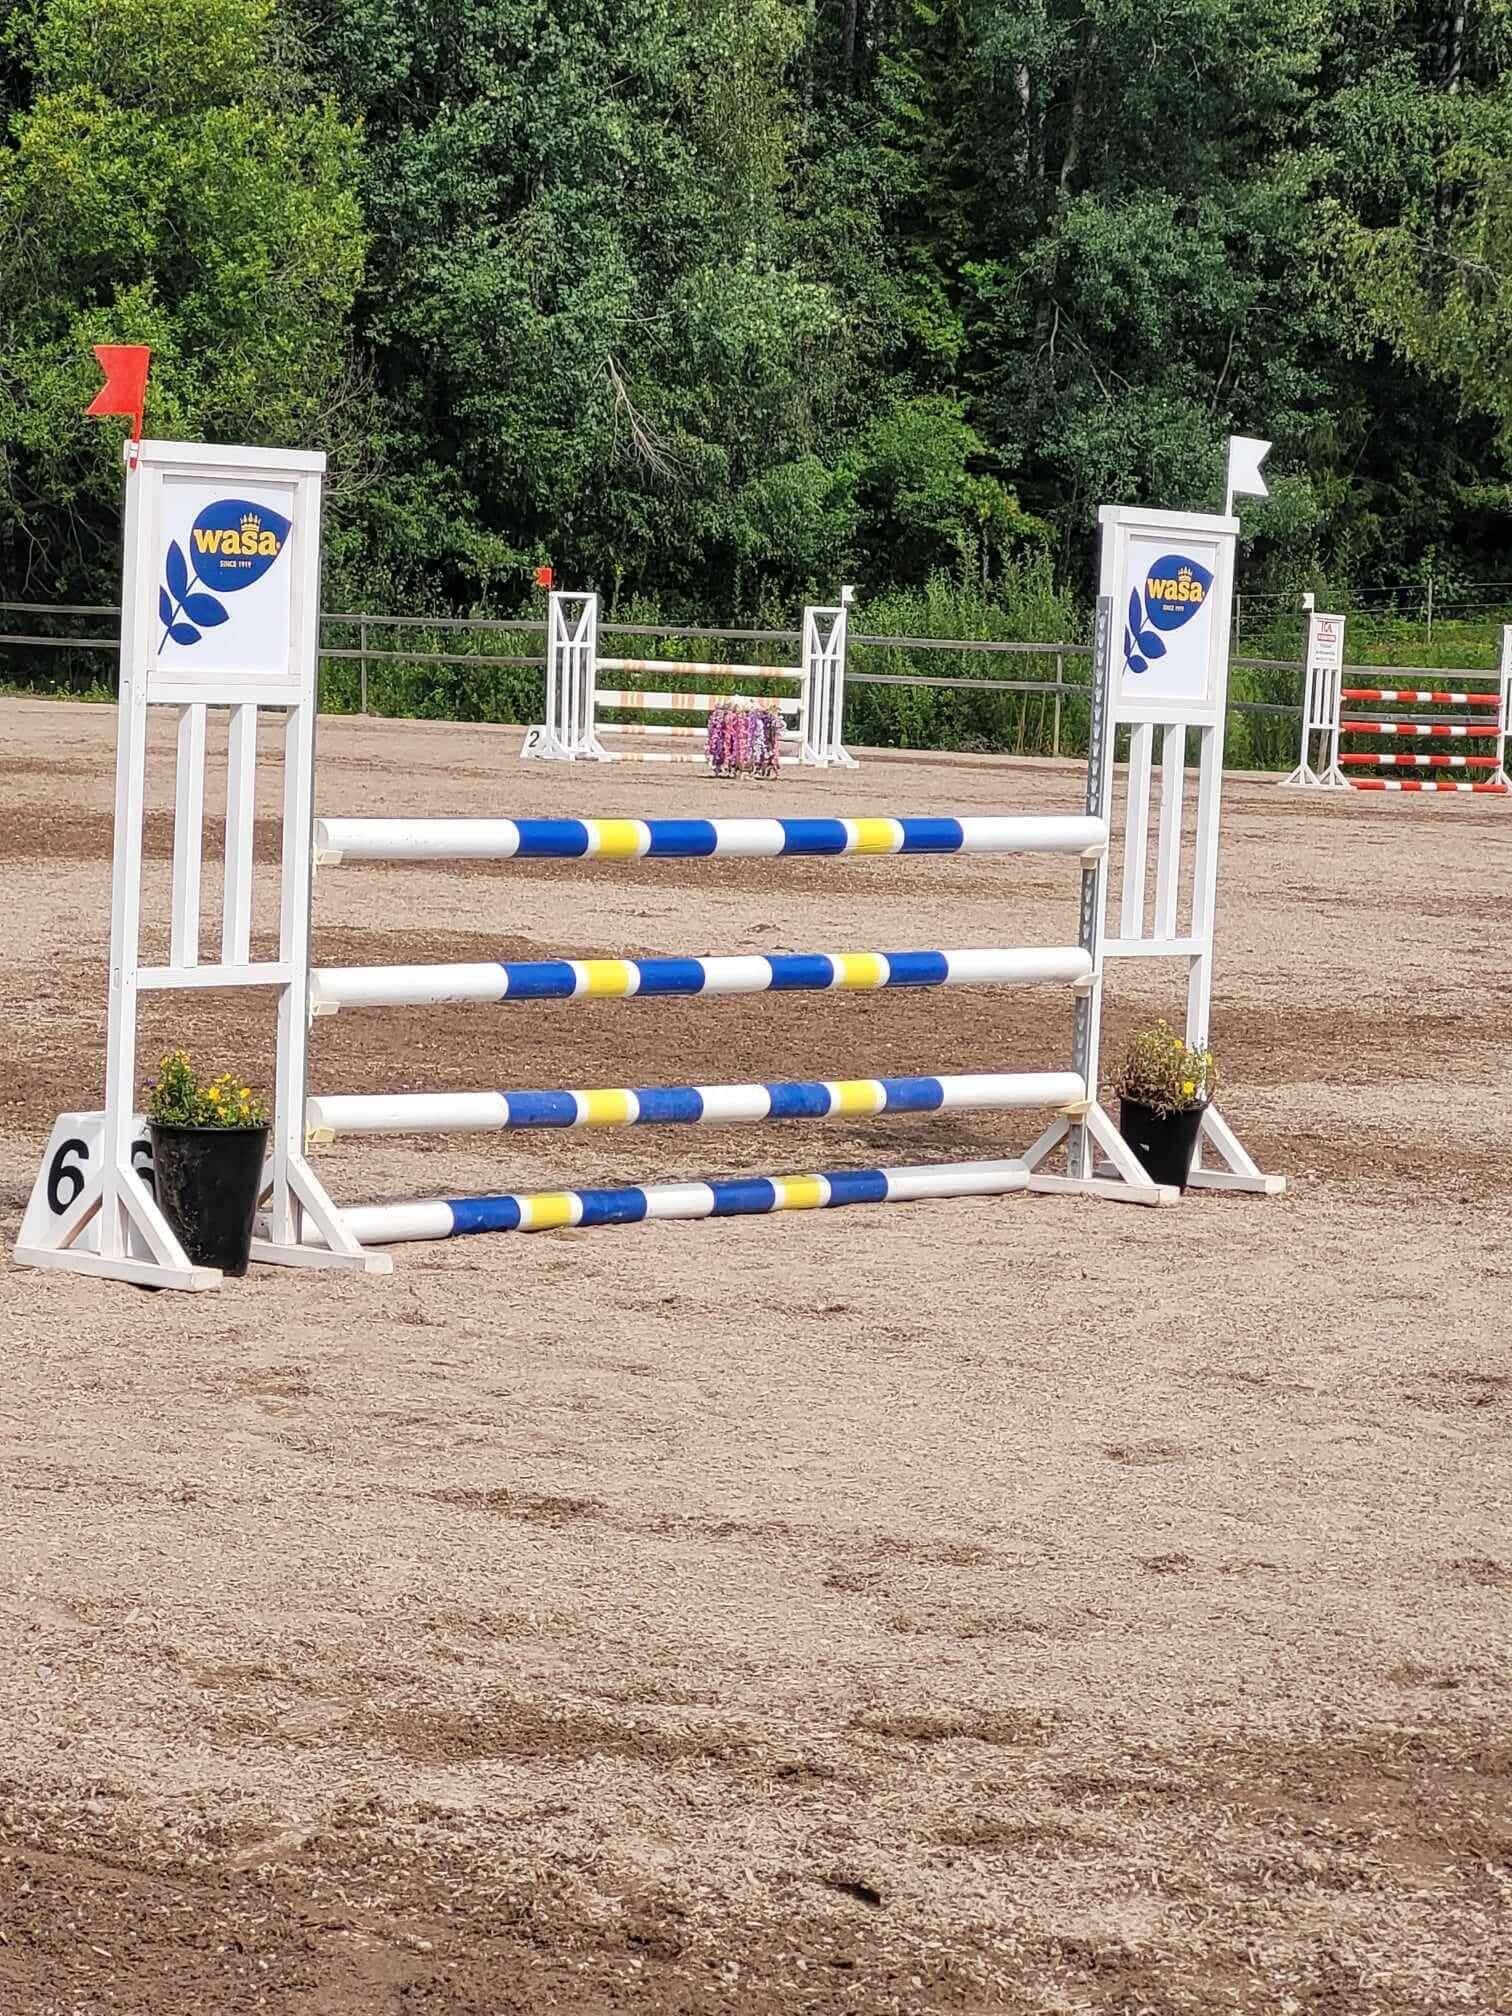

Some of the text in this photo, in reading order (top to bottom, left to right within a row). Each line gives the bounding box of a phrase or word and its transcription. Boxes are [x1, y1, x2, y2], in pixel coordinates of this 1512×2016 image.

[193, 528, 278, 556] wasa
[1147, 577, 1203, 603] wasa
[528, 730, 540, 748] 2
[47, 1138, 89, 1216] 6
